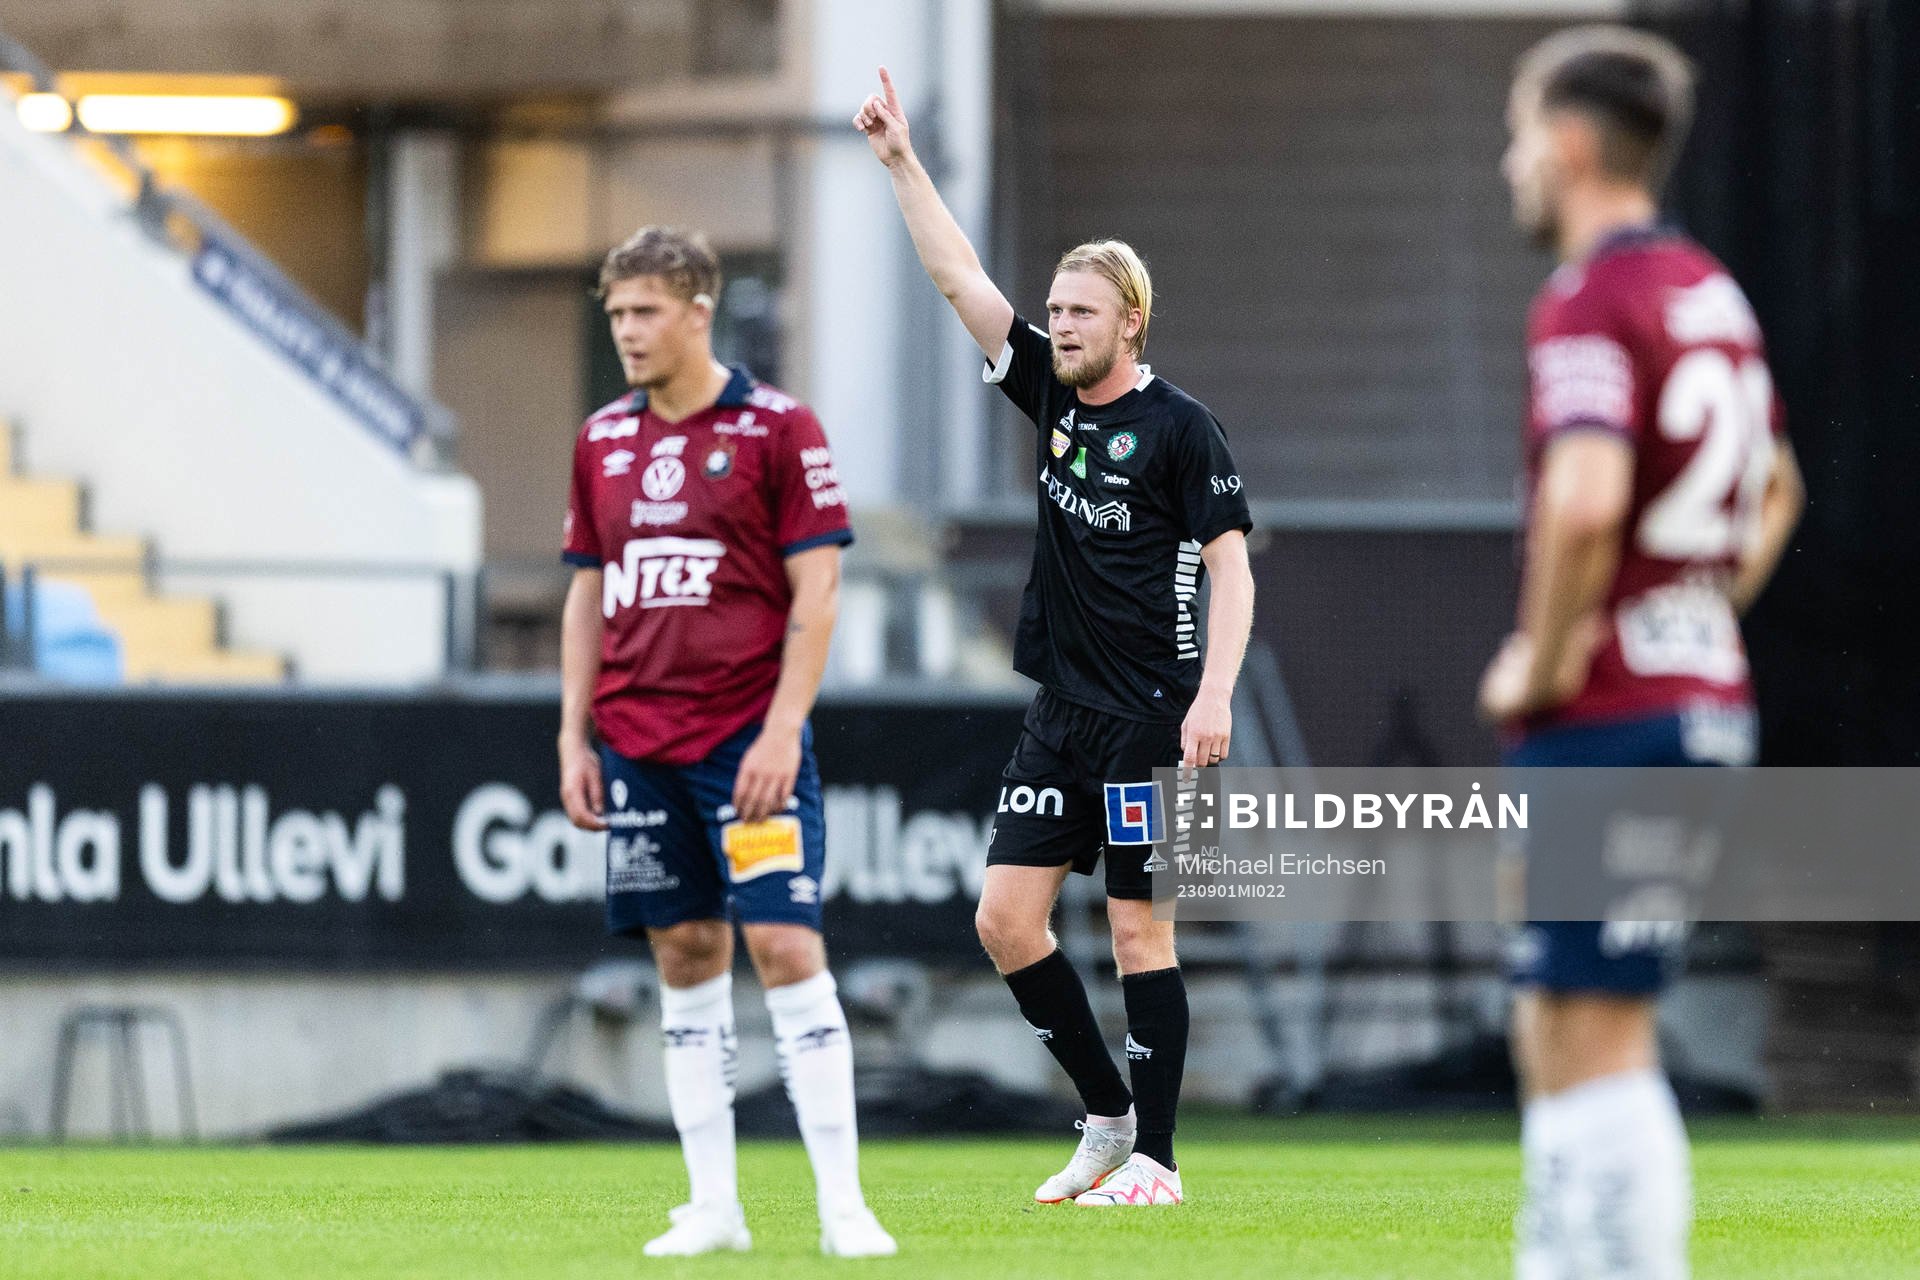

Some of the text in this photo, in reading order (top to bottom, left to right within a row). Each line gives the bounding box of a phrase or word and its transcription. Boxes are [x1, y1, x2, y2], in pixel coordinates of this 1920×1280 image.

[1101, 472, 1130, 486] rebro
[1211, 474, 1244, 495] 819
[139, 785, 405, 902] Ullevi
